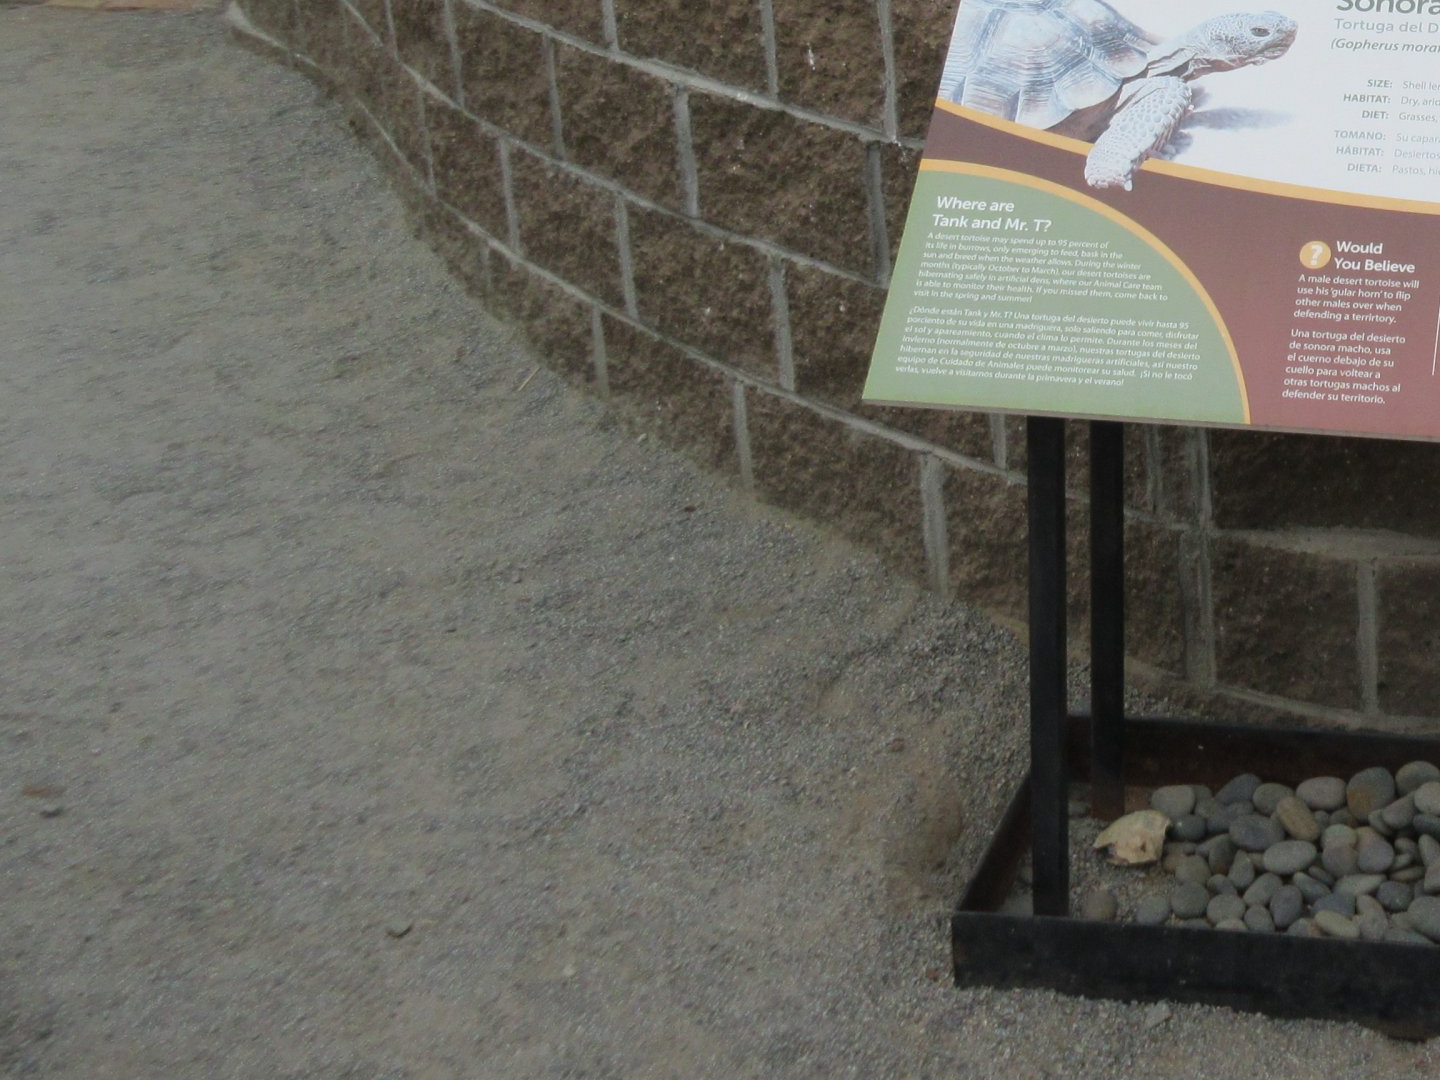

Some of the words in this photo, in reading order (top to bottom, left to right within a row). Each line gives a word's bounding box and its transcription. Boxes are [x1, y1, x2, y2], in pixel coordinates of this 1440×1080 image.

[1333, 17, 1394, 34] Tortuga
[1398, 21, 1422, 33] del
[1330, 37, 1399, 52] (Gopherus
[1402, 80, 1427, 90] Shell
[936, 195, 987, 211] Where
[988, 201, 1015, 212] are
[932, 213, 969, 228] Tank
[970, 216, 1002, 229] and
[1004, 217, 1028, 231] Mr.
[1033, 218, 1052, 232] T?
[1336, 240, 1383, 254] Would
[1333, 256, 1361, 270] You
[1364, 258, 1415, 273] Believe
[1298, 273, 1306, 282] A
[1307, 274, 1331, 284] male
[1332, 275, 1363, 285] desert
[1364, 278, 1401, 288] tortoise
[1402, 279, 1420, 289] will
[913, 288, 930, 297] visit
[939, 290, 953, 298] the
[954, 291, 980, 301] spring
[980, 292, 997, 301] and
[1296, 286, 1314, 295] use
[1314, 285, 1329, 296] his
[1383, 290, 1394, 299] to
[1395, 290, 1411, 302] flip
[1294, 296, 1321, 307] other
[1322, 298, 1350, 309] males
[1351, 301, 1374, 310] over
[1375, 301, 1402, 312] when
[1292, 308, 1342, 322] defending
[1290, 328, 1310, 338] Una
[1311, 330, 1348, 342] tortuga
[1349, 331, 1365, 341] del
[1366, 332, 1406, 344] desierto
[1288, 339, 1302, 350] de
[1302, 342, 1336, 352] sonora
[1374, 347, 1391, 355] usa
[1286, 351, 1297, 362] el
[1297, 354, 1331, 364] cuerno
[1332, 354, 1367, 367] debajo
[1368, 356, 1381, 367] de
[1382, 359, 1394, 367] su
[1284, 364, 1315, 375] cuello
[1315, 368, 1338, 377] para
[1339, 367, 1373, 378] voltear
[1374, 371, 1381, 379] a
[1283, 377, 1308, 387] otras
[1309, 378, 1350, 391] tortugas
[1351, 381, 1390, 392] machos
[1391, 382, 1401, 392] al
[1281, 388, 1326, 400] defender
[1326, 393, 1339, 401] su
